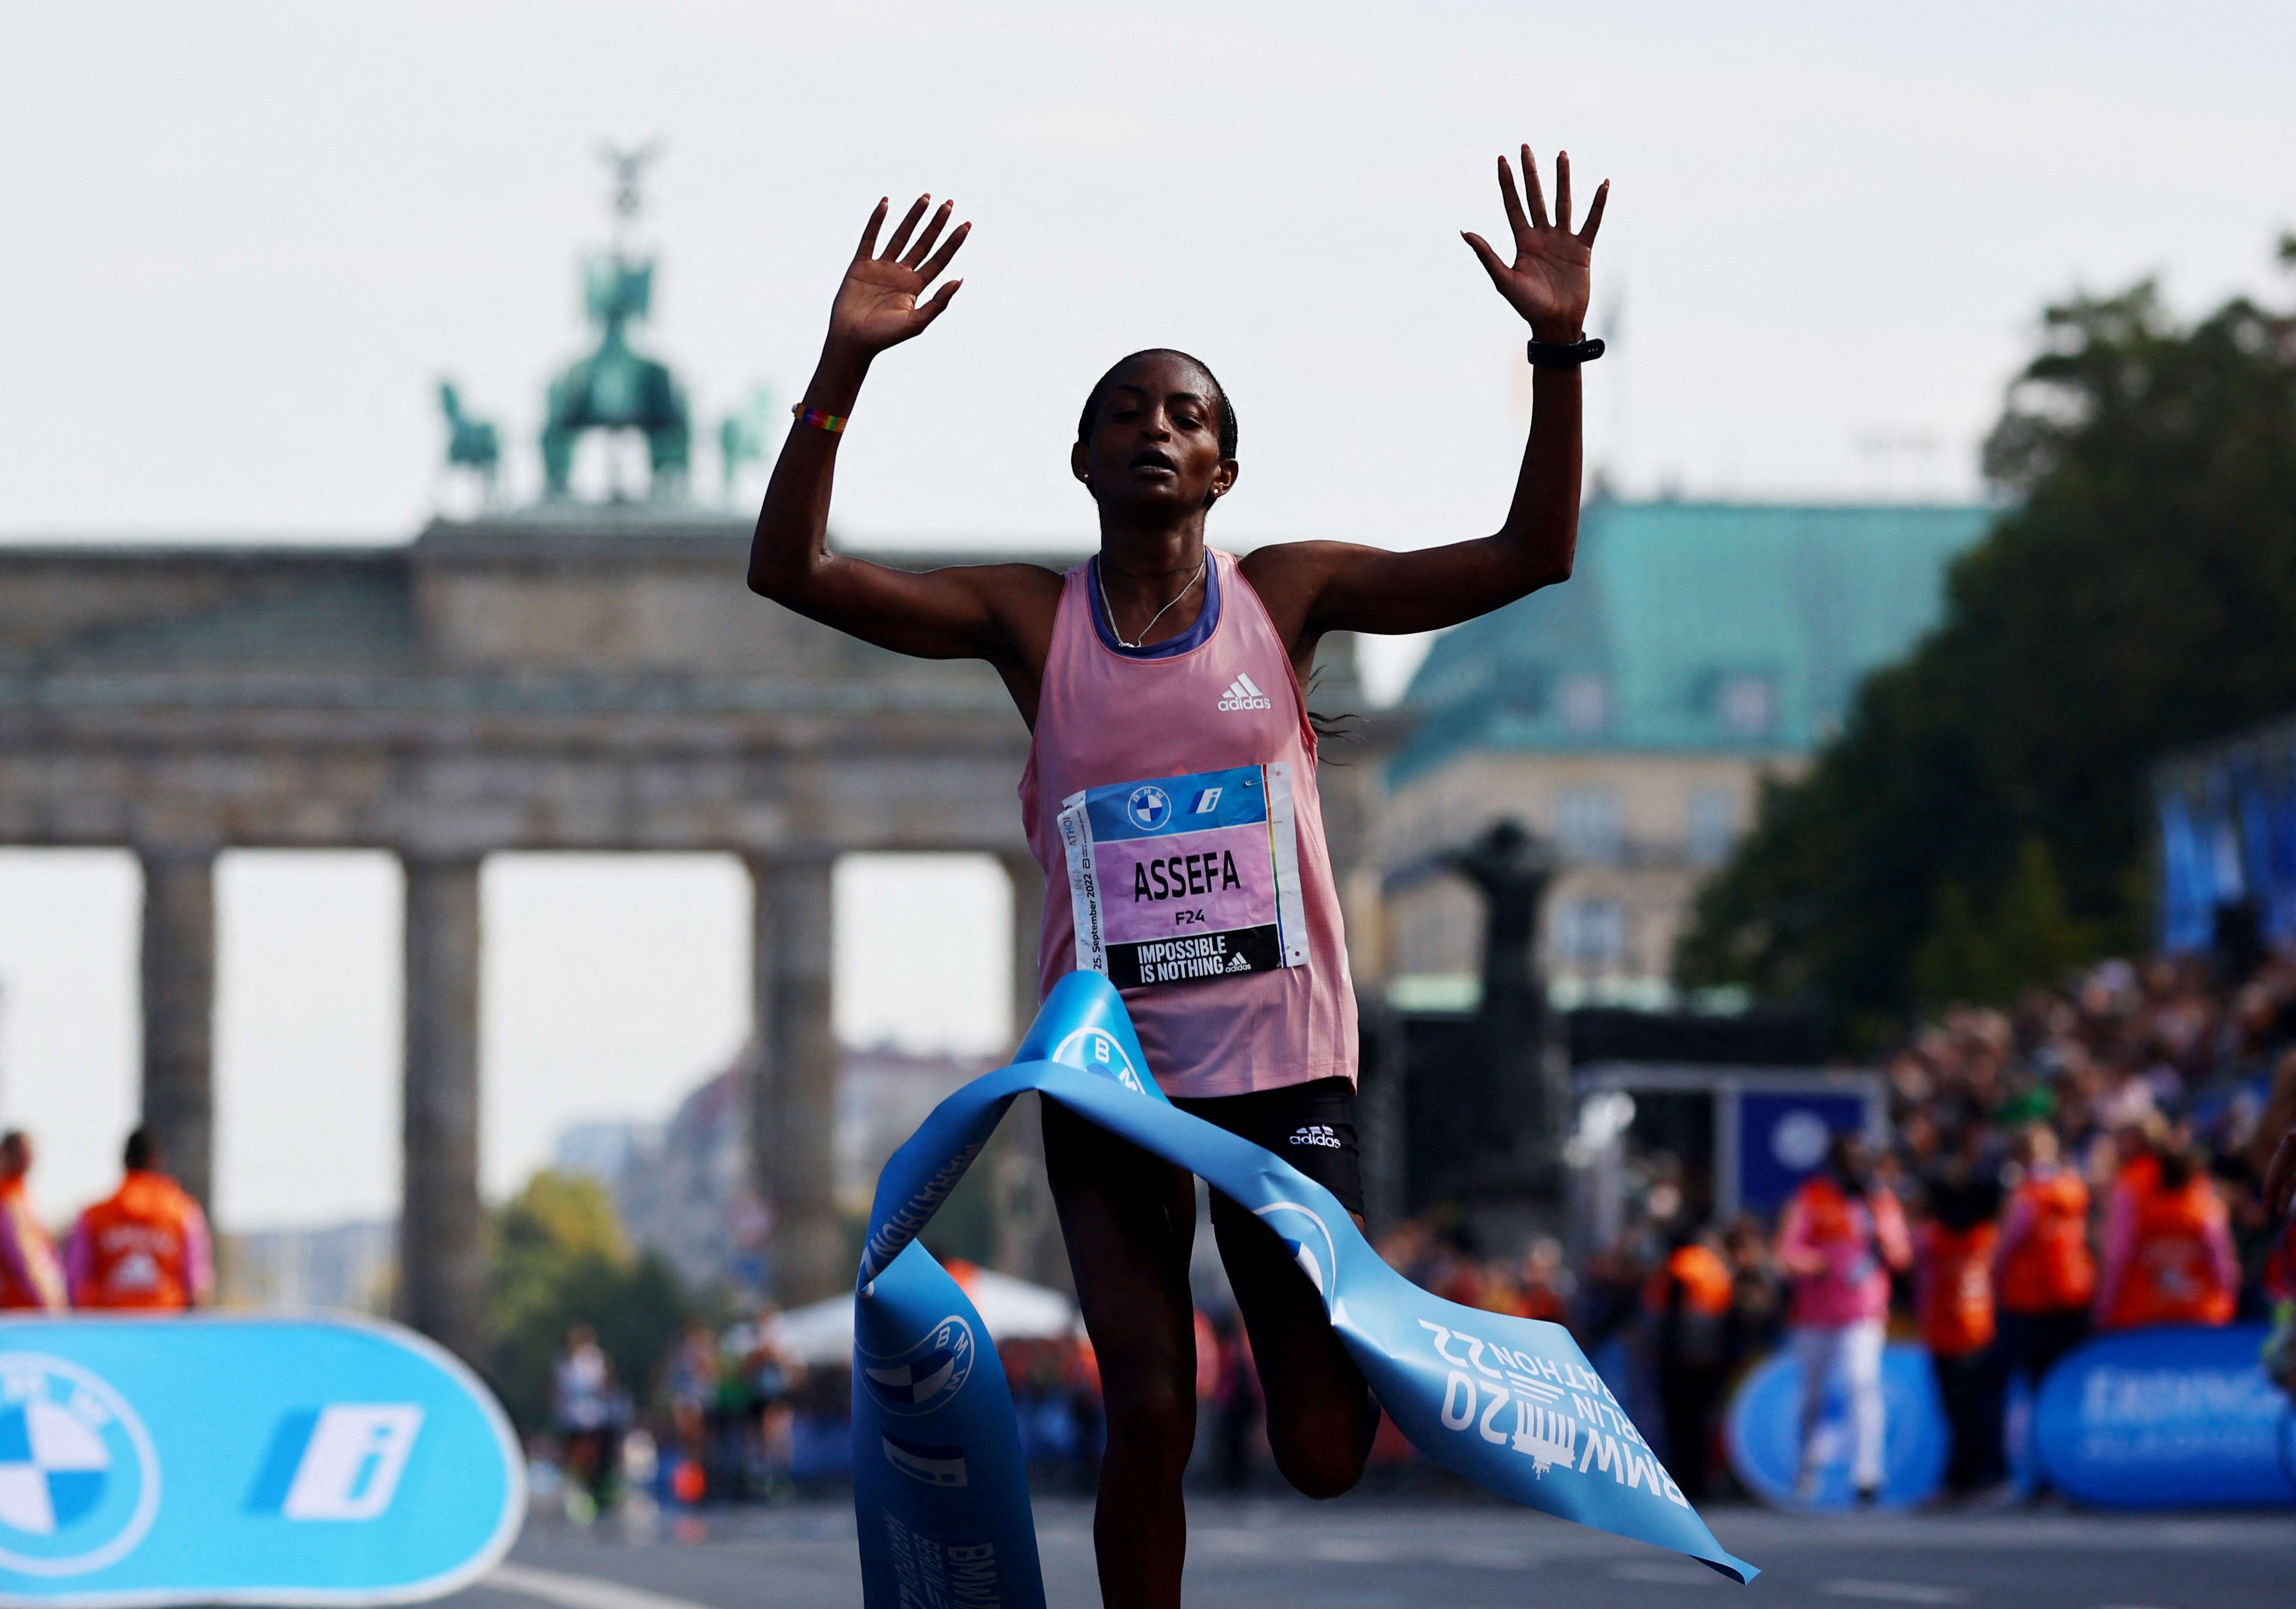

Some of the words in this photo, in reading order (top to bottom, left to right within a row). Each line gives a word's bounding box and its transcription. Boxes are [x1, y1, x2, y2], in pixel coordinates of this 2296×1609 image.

[1217, 696, 1271, 712] adidas
[1133, 788, 1164, 803] BMW
[1084, 873, 1095, 899] 2022
[1135, 850, 1241, 903] ASSEFA
[1089, 900, 1101, 953] September
[1176, 909, 1205, 926] F24
[1093, 954, 1102, 970] 25.
[1138, 936, 1227, 964] IMPOSSIBLE
[1140, 964, 1155, 983] IS
[1157, 955, 1224, 981] NOTHING
[1225, 963, 1251, 973] adidas
[1095, 1037, 1138, 1091] BM
[1289, 1133, 1341, 1148] adidas
[934, 1326, 969, 1390] BMW
[1418, 1318, 1503, 1379] 22
[1488, 1342, 1620, 1408] RATHON
[1441, 1370, 1510, 1445] 20
[1579, 1427, 1689, 1510] BMW
[948, 1542, 999, 1600] BMW
